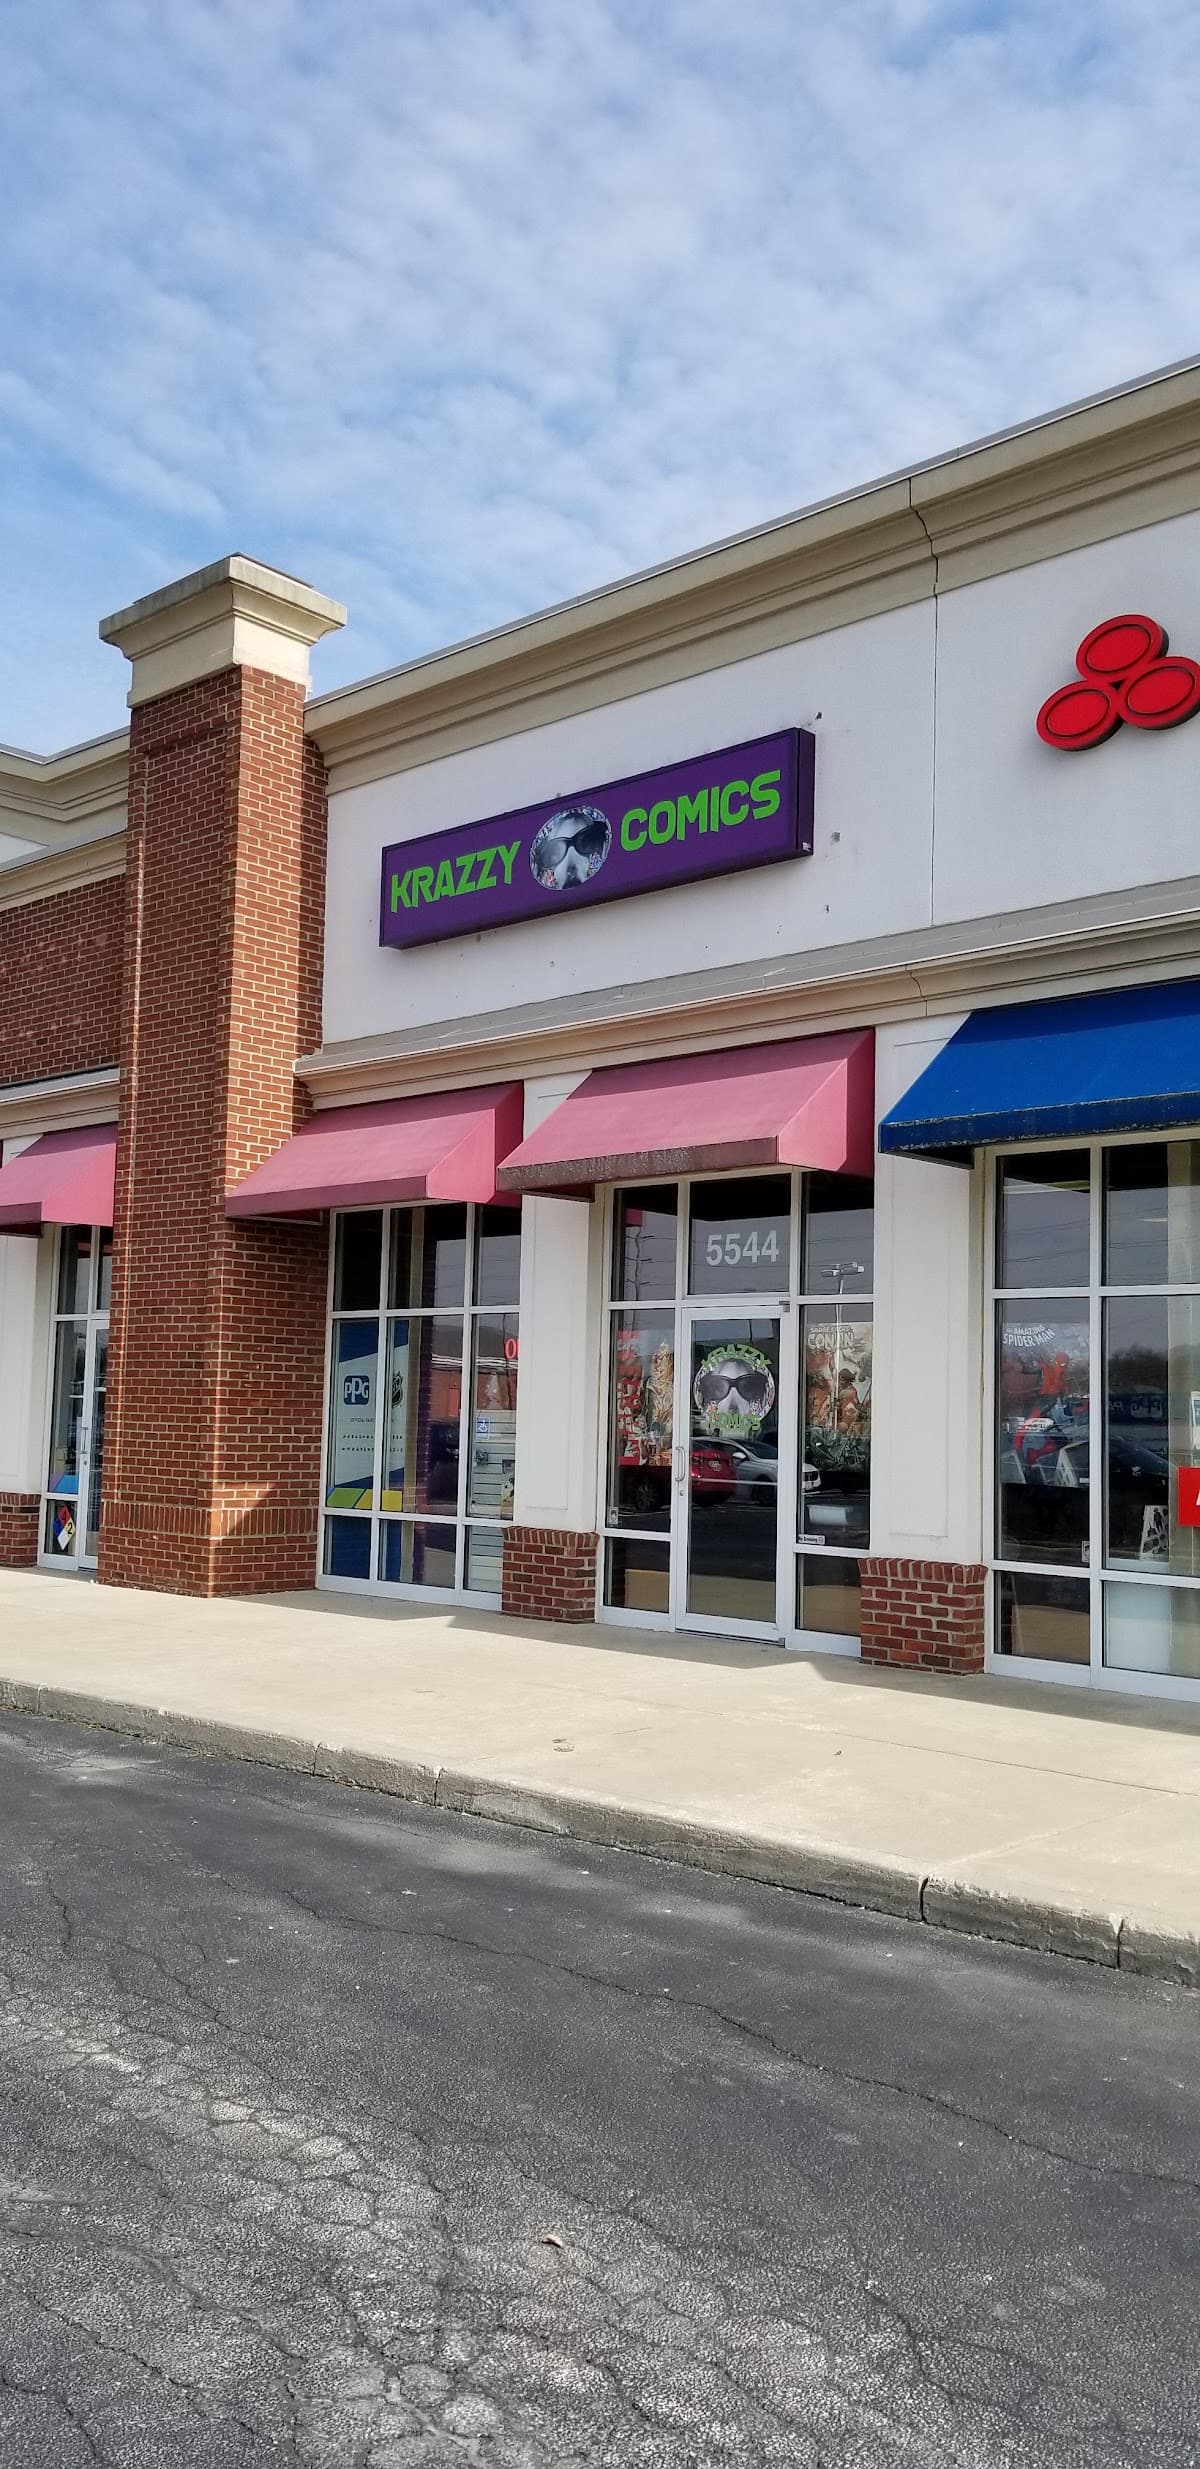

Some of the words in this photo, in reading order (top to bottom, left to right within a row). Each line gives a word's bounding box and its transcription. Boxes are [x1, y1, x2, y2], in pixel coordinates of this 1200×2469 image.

[391, 841, 521, 912] KRAZZY
[620, 769, 781, 852] COMICS
[705, 1230, 779, 1265] 5544
[67, 1522, 73, 1534] 2
